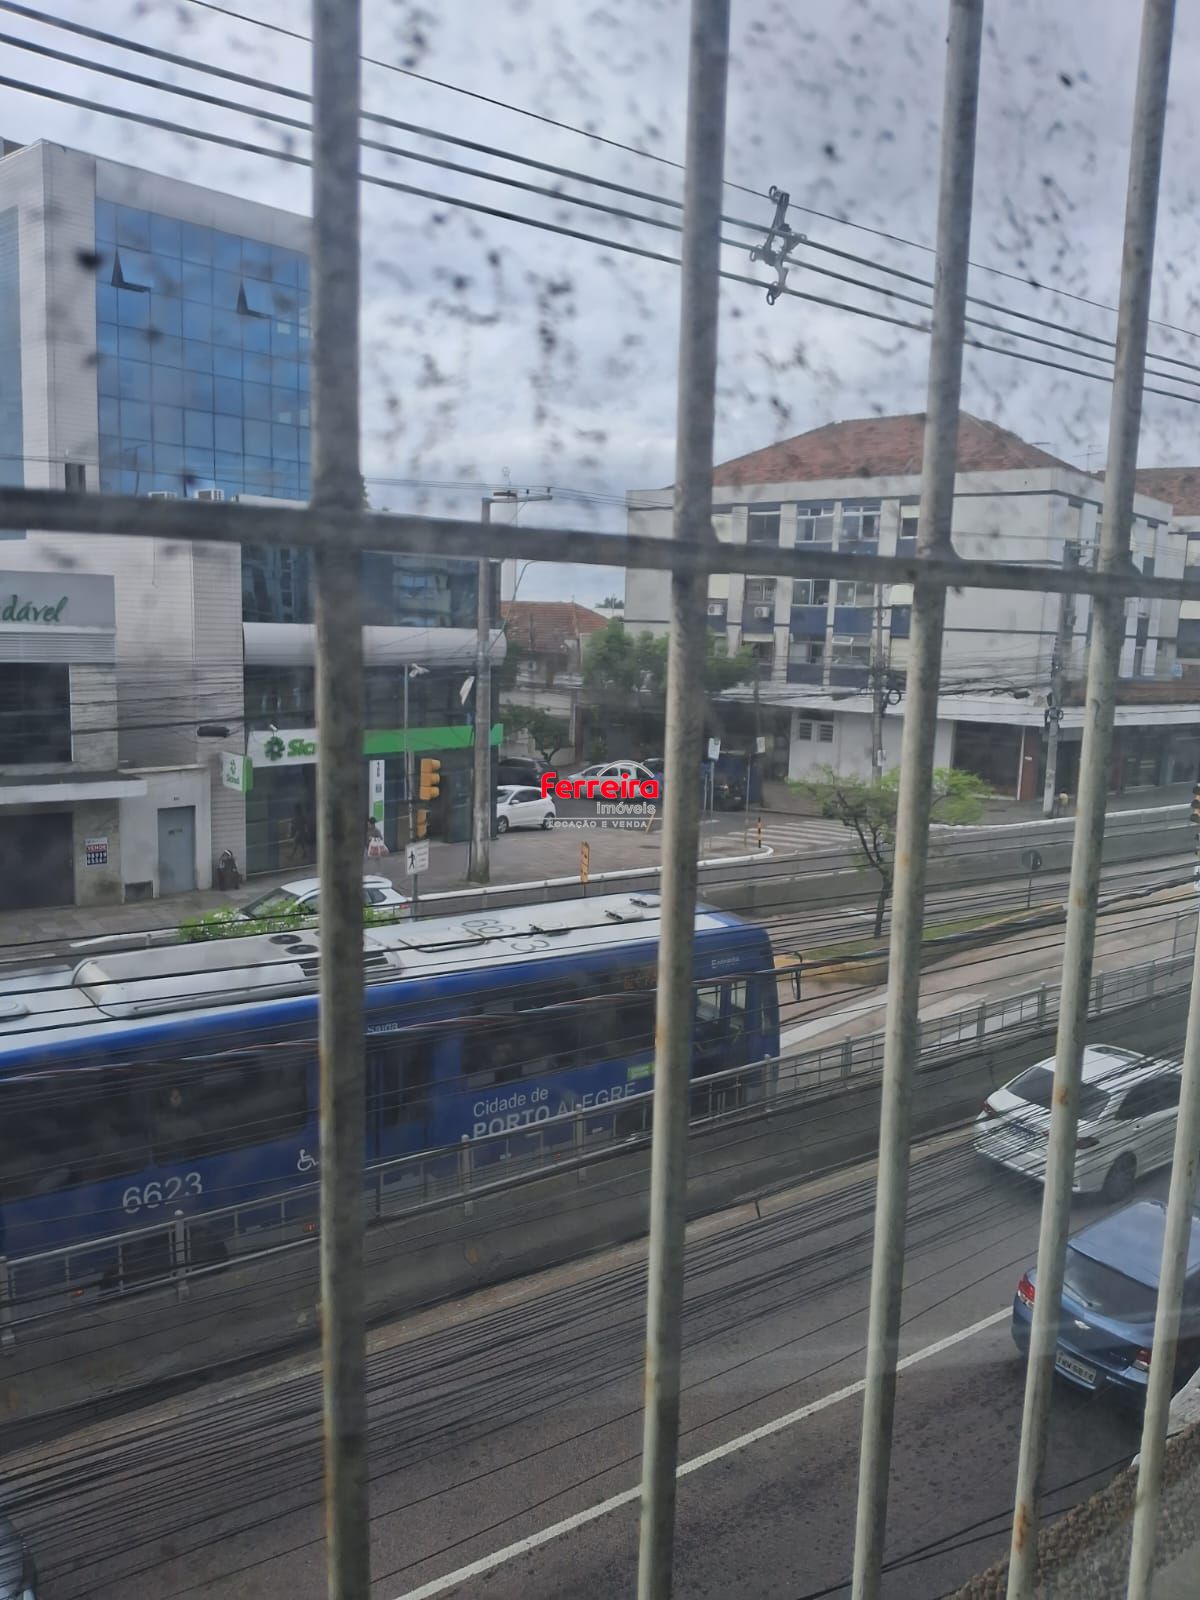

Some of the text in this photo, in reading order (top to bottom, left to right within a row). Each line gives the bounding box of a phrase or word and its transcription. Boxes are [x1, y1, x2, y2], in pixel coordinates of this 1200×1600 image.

[0, 594, 69, 622] dável
[473, 1087, 549, 1118] Cidade de
[473, 1105, 550, 1139] PORTO
[122, 1172, 203, 1214] 6623
